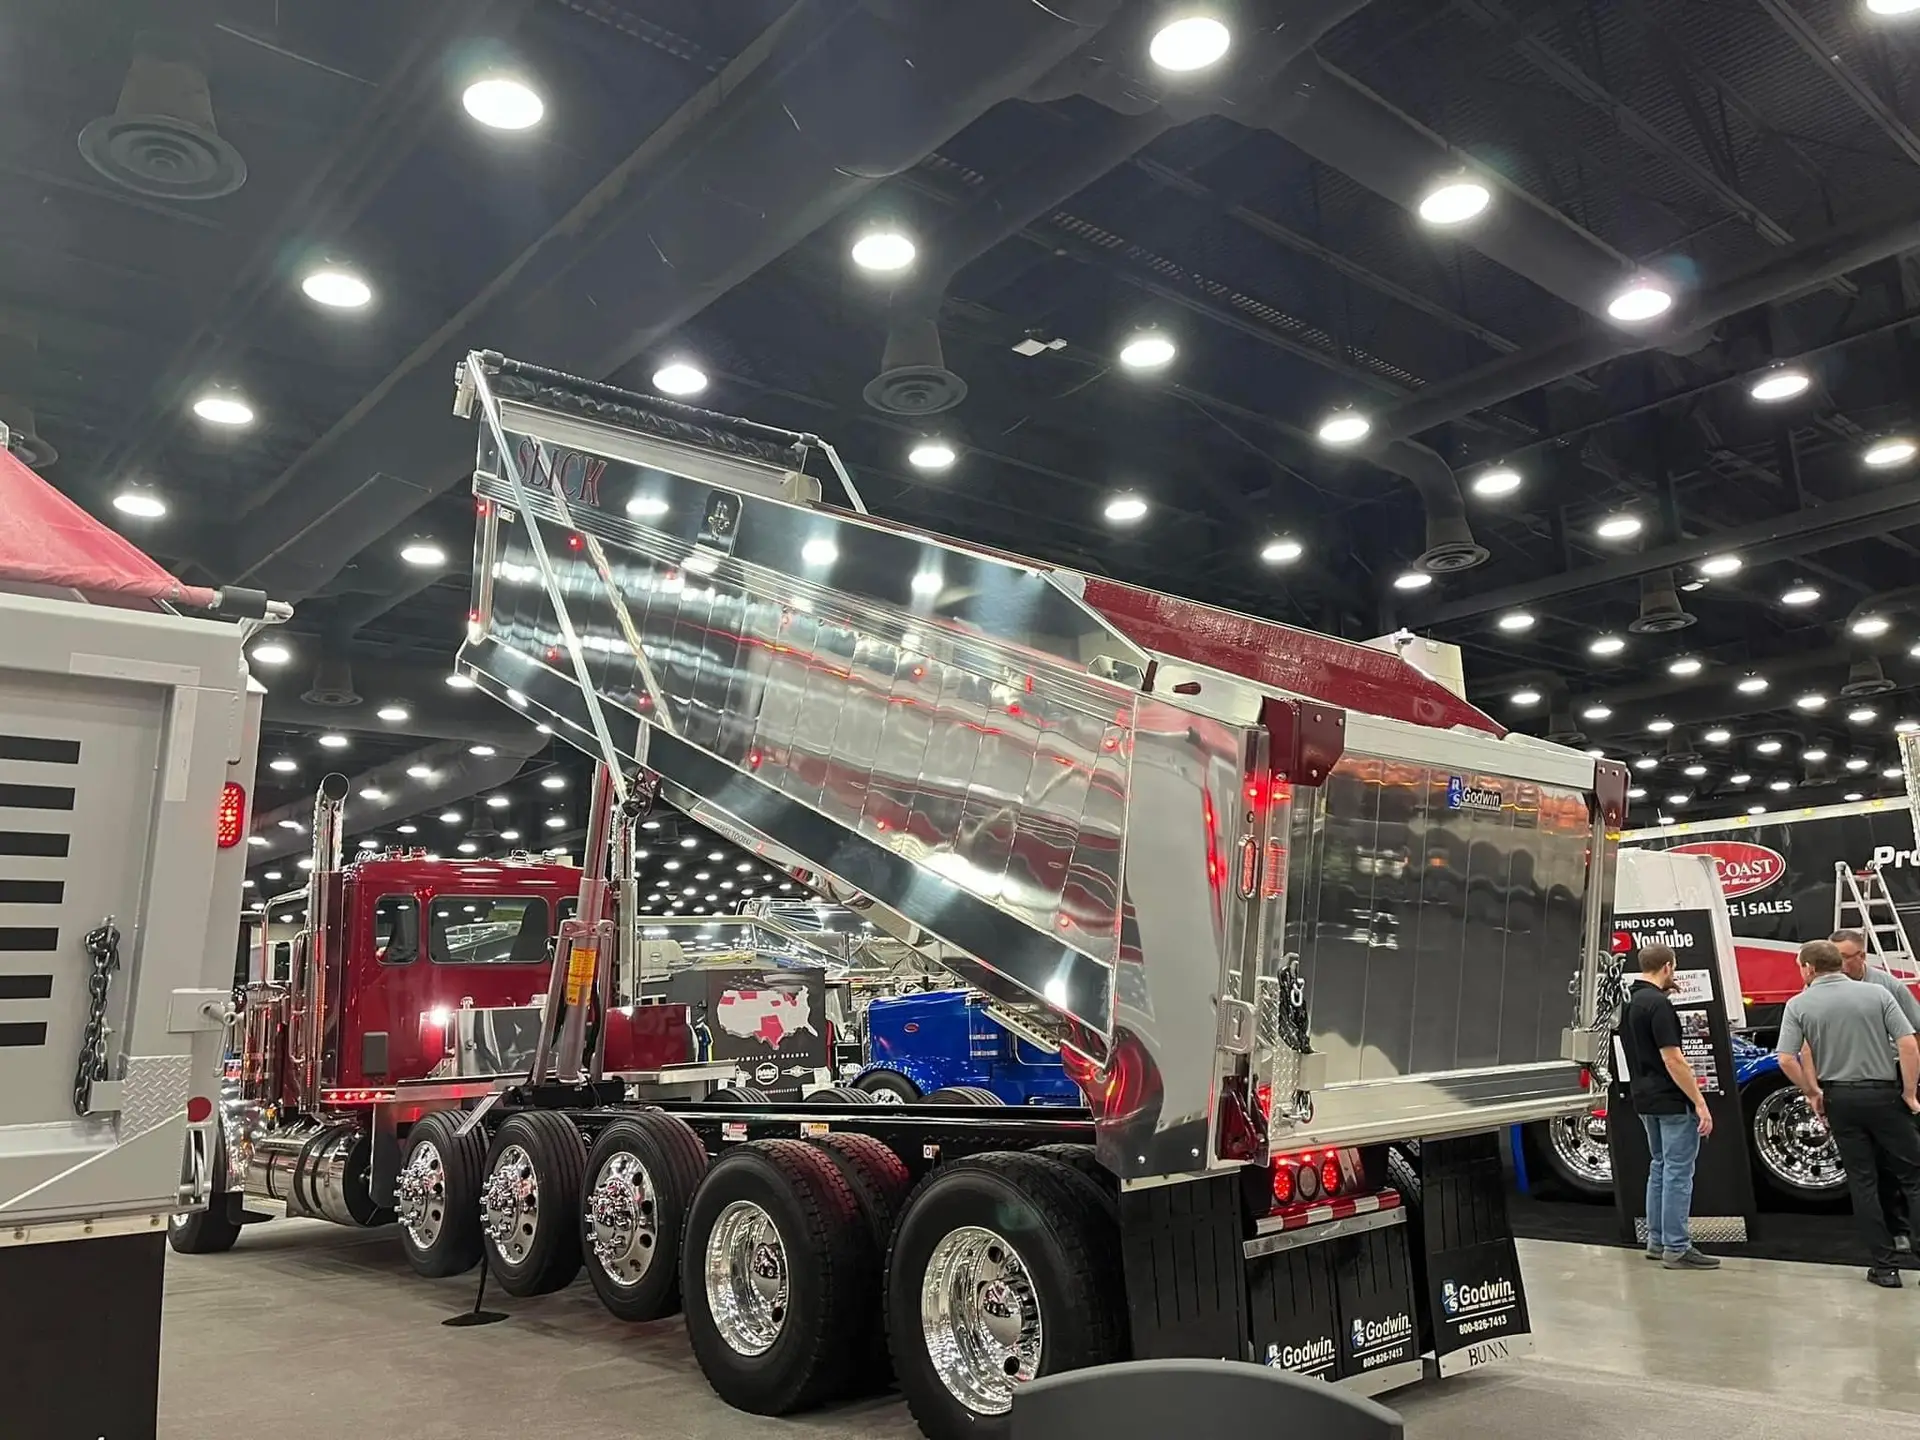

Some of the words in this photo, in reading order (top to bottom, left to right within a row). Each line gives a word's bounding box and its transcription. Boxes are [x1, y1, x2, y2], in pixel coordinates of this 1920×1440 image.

[1463, 787, 1500, 807] Godwin
[1713, 858, 1774, 878] COAST
[1748, 900, 1793, 915] SALES
[1614, 919, 1640, 930] FIND
[1641, 918, 1656, 928] US
[1657, 917, 1674, 927] ON
[1632, 929, 1694, 950] YouTube
[1468, 1338, 1510, 1367] BUNN
